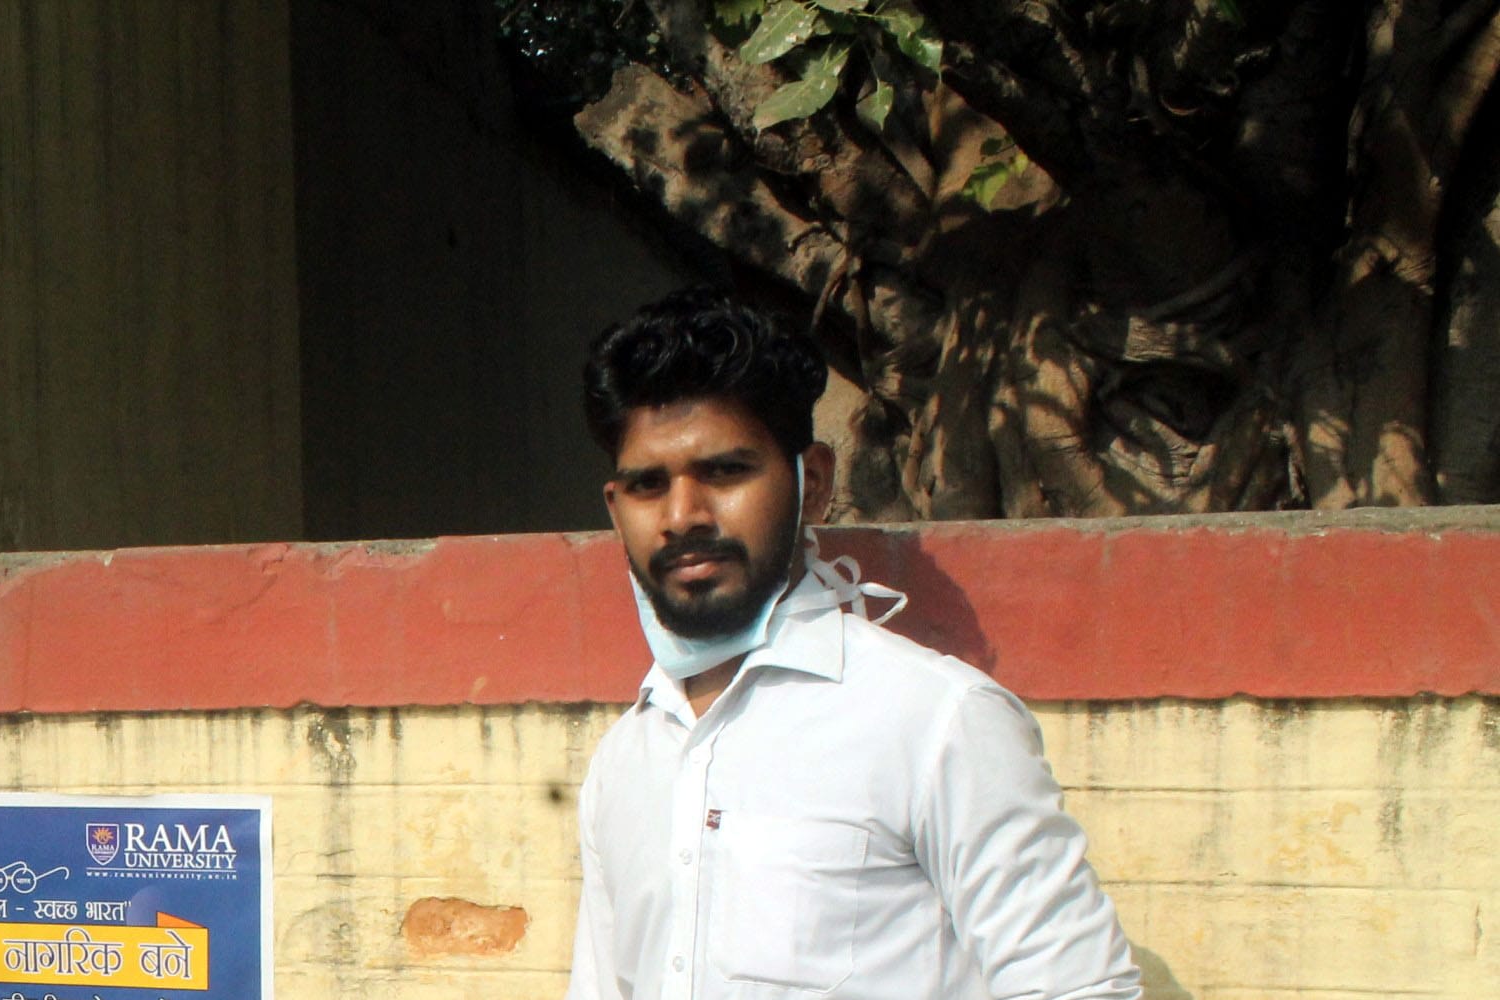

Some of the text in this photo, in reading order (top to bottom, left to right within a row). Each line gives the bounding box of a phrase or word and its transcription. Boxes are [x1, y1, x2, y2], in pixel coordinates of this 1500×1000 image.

[125, 823, 236, 853] RAMA
[123, 853, 237, 870] UNIVERSITY
[34, 901, 77, 919] स्वच्छ
[3, 928, 123, 976] नागरिक
[139, 929, 193, 978] बने
